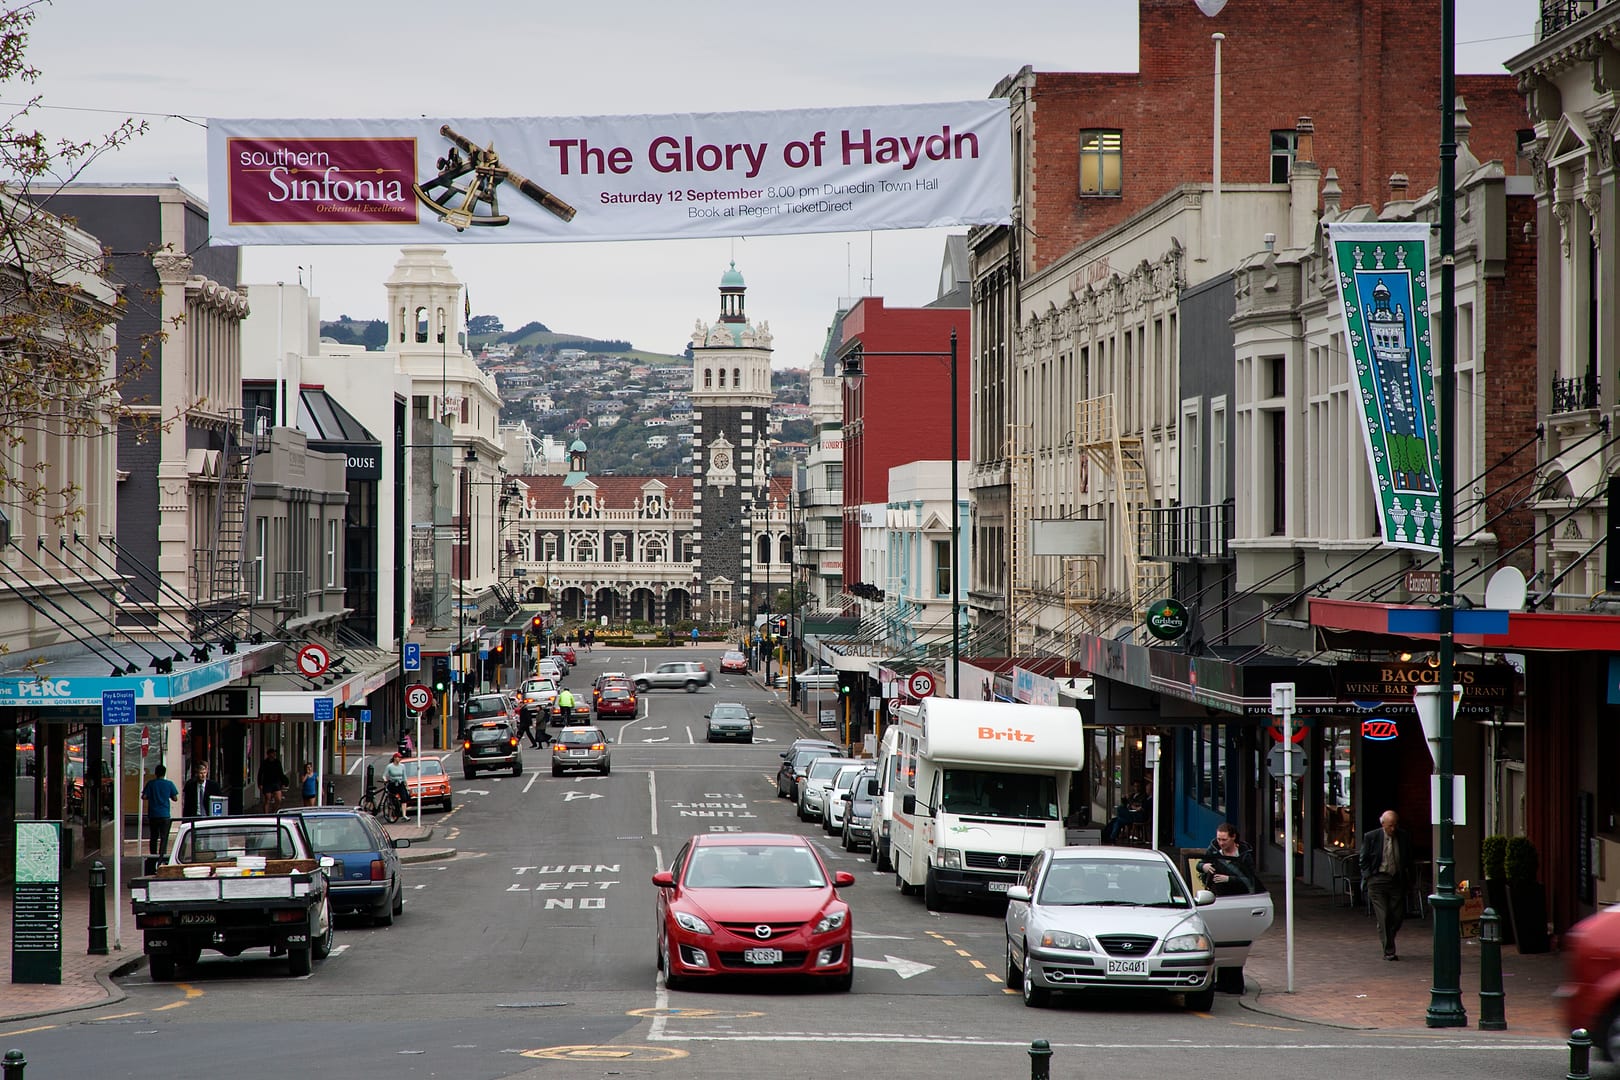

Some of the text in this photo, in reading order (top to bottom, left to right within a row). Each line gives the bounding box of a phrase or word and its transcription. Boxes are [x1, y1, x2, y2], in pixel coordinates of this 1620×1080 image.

[240, 147, 329, 166] southern
[550, 126, 979, 178] The Glory of Haydn
[268, 166, 405, 201] Sinfonia
[600, 178, 938, 206] Saturday 12 September 8.00 pm Dunedin Town Hall
[316, 204, 406, 213] Orchestral Excellence
[688, 201, 853, 219] Book at Regent TicketDirect
[346, 457, 374, 468] OUSE
[1410, 574, 1431, 592] Excursion
[1152, 615, 1182, 627] Carlsberg
[408, 647, 416, 656] P
[18, 680, 71, 696] PERC
[915, 680, 930, 690] 50
[1346, 684, 1379, 693] WINE
[1385, 685, 1408, 694] BAR
[412, 694, 426, 704] 50
[978, 727, 1035, 743] Britz
[1361, 723, 1398, 737] PIZZA
[214, 804, 221, 813] P
[512, 864, 620, 875] TURN
[506, 881, 620, 891] LEFT
[544, 898, 605, 909] NO
[745, 952, 780, 960] EKC891
[1109, 961, 1145, 972] BZG401
